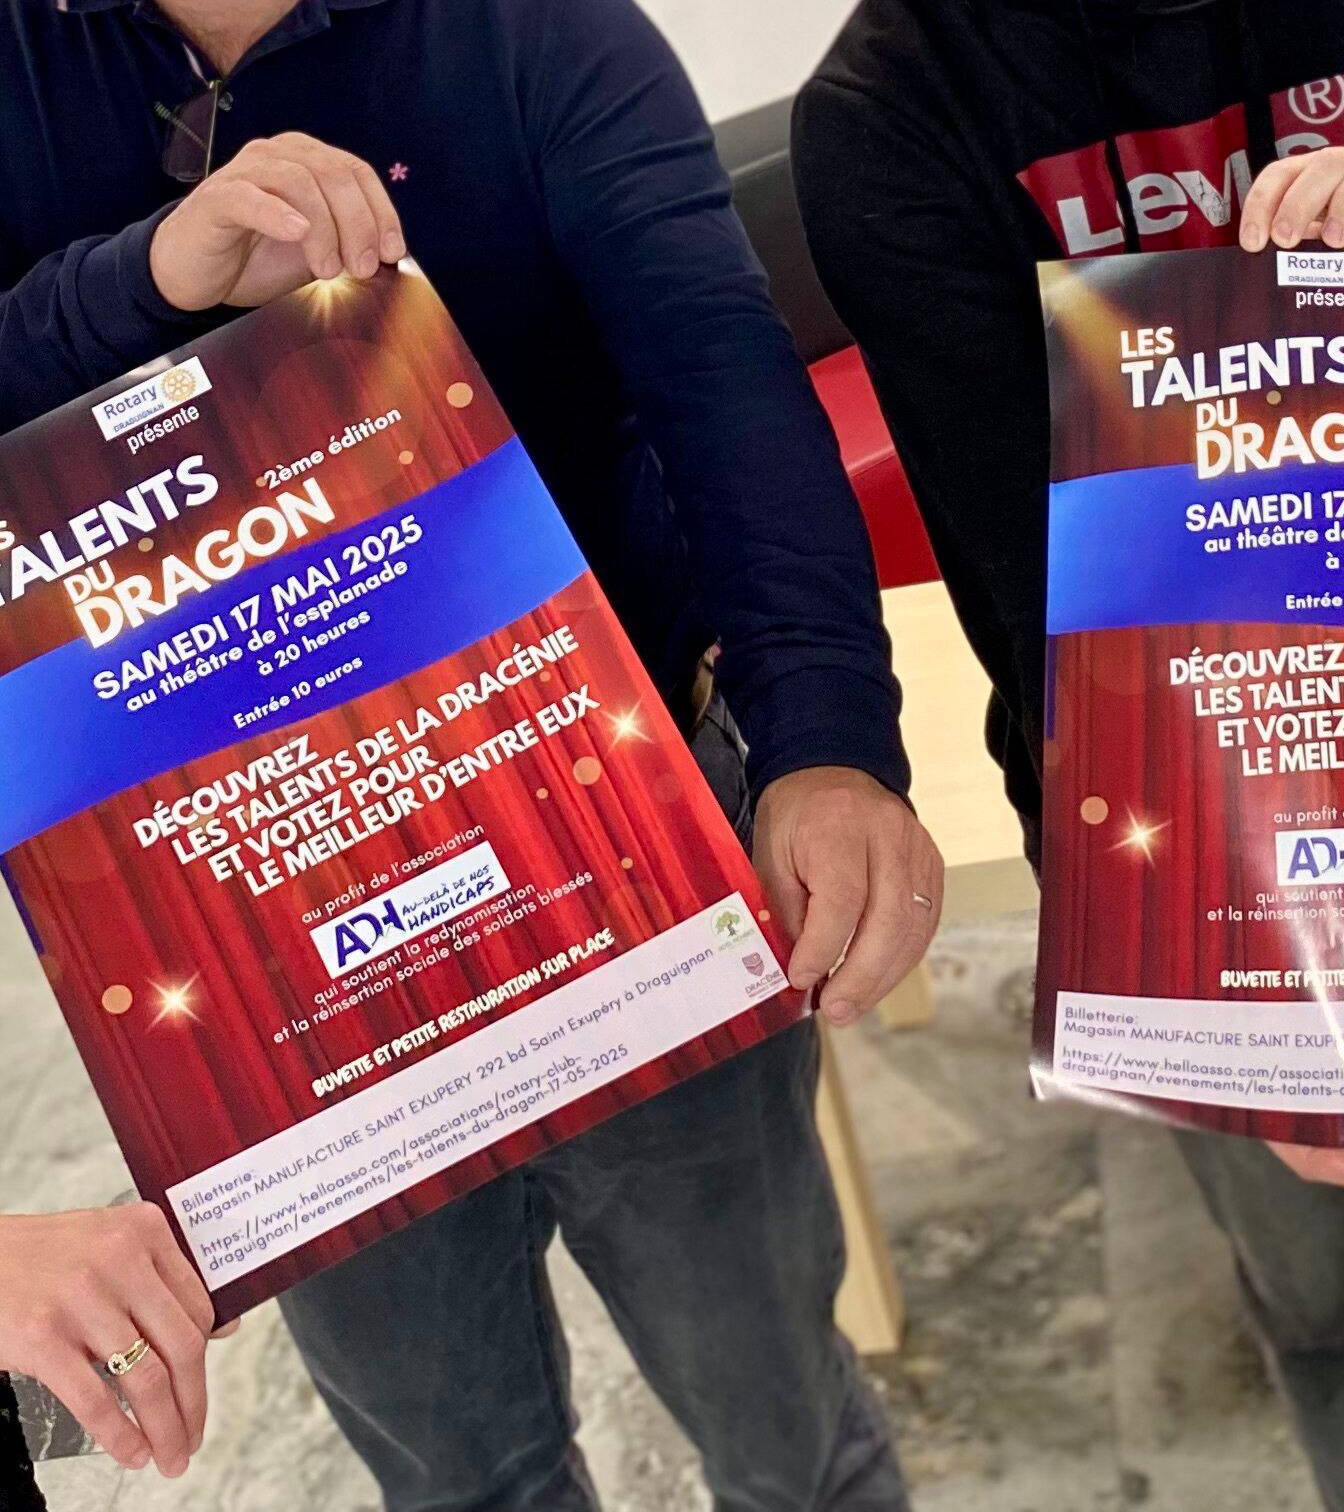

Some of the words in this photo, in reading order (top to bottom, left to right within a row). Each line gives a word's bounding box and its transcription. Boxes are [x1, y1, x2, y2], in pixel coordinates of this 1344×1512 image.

[1287, 255, 1343, 272] Rotary
[1120, 326, 1175, 358] LES
[102, 384, 158, 420] Rotary
[1196, 397, 1237, 433] DU
[126, 405, 200, 455] présente
[262, 449, 325, 490] 2ème
[327, 408, 402, 455] édition
[1186, 497, 1312, 532] SAMEDI
[72, 476, 336, 650] DRAGON
[1204, 535, 1230, 553] au
[1236, 527, 1318, 549] théâtre
[1326, 552, 1340, 570] à
[62, 558, 116, 605] DU
[1286, 593, 1342, 610] Entrée
[92, 614, 230, 700] SAMEDI
[228, 594, 260, 632] 17
[270, 556, 342, 614] MAI
[341, 513, 423, 575] 2025
[256, 658, 274, 676] à
[273, 642, 301, 668] 20
[300, 610, 372, 653] heures
[125, 688, 157, 712] au
[158, 645, 243, 695] théâtre
[246, 628, 277, 652] de
[232, 694, 291, 729] Entrée
[290, 680, 312, 699] 10
[314, 656, 363, 689] euros
[1195, 687, 1243, 717] LES
[171, 817, 230, 865] LES
[224, 748, 358, 833] TALENTS
[354, 726, 400, 767] DE
[395, 706, 443, 745] LA
[436, 624, 580, 721] DRACÉNIE
[1217, 718, 1250, 748] ET
[1242, 747, 1273, 777] LE
[132, 732, 320, 848] DÉCOUVREZ
[206, 843, 245, 882] ET
[243, 787, 353, 858] VOTEZ
[347, 744, 439, 807] POUR
[243, 857, 285, 897] LE
[281, 785, 423, 877] MEILLEUR
[534, 683, 601, 737] EUX
[1274, 811, 1292, 823] au
[1297, 807, 1337, 826] profit
[300, 906, 323, 924] au
[323, 881, 367, 917] profit
[369, 872, 390, 889] de
[451, 876, 467, 890] DE
[468, 863, 490, 882] NOS
[1256, 889, 1278, 905] qui
[1284, 887, 1343, 903] soutient
[406, 874, 495, 931] HANDICAPS
[1207, 907, 1223, 921] et
[1229, 906, 1242, 921] la
[1248, 904, 1327, 920] réinsertion
[272, 1025, 290, 1044] et
[290, 1018, 311, 1034] la
[311, 975, 394, 1025] réinsertion
[394, 946, 451, 982] sociale
[452, 930, 482, 952] des
[481, 900, 538, 936] soldats
[535, 871, 594, 906] blessés
[313, 982, 339, 1005] qui
[340, 949, 402, 991] soutient
[403, 942, 422, 957] la
[422, 883, 537, 951] redynamisation
[1220, 970, 1282, 988] BUVETTE
[1284, 969, 1302, 988] ET
[311, 1053, 375, 1098] BUVETTE
[371, 1042, 392, 1067] ET
[390, 1019, 440, 1058] PETITE
[437, 966, 542, 1033] RESTAURATION
[539, 951, 572, 980] SUR
[566, 926, 615, 964] PLACE
[1064, 1021, 1126, 1038] Magasin
[1130, 1028, 1242, 1046] MANUFACTURE
[1248, 1034, 1288, 1047] SAINT
[187, 1190, 252, 1229] Magasin
[253, 1128, 364, 1195] MANUFACTURE
[364, 1105, 406, 1137] SAINT
[407, 1071, 472, 1115] EXUPERY
[475, 1055, 506, 1080] 292
[505, 1043, 528, 1064] bd
[528, 1024, 567, 1052] Saint
[566, 996, 622, 1032] Exupéry
[623, 990, 635, 1002] à
[634, 947, 714, 996] Draguignan
